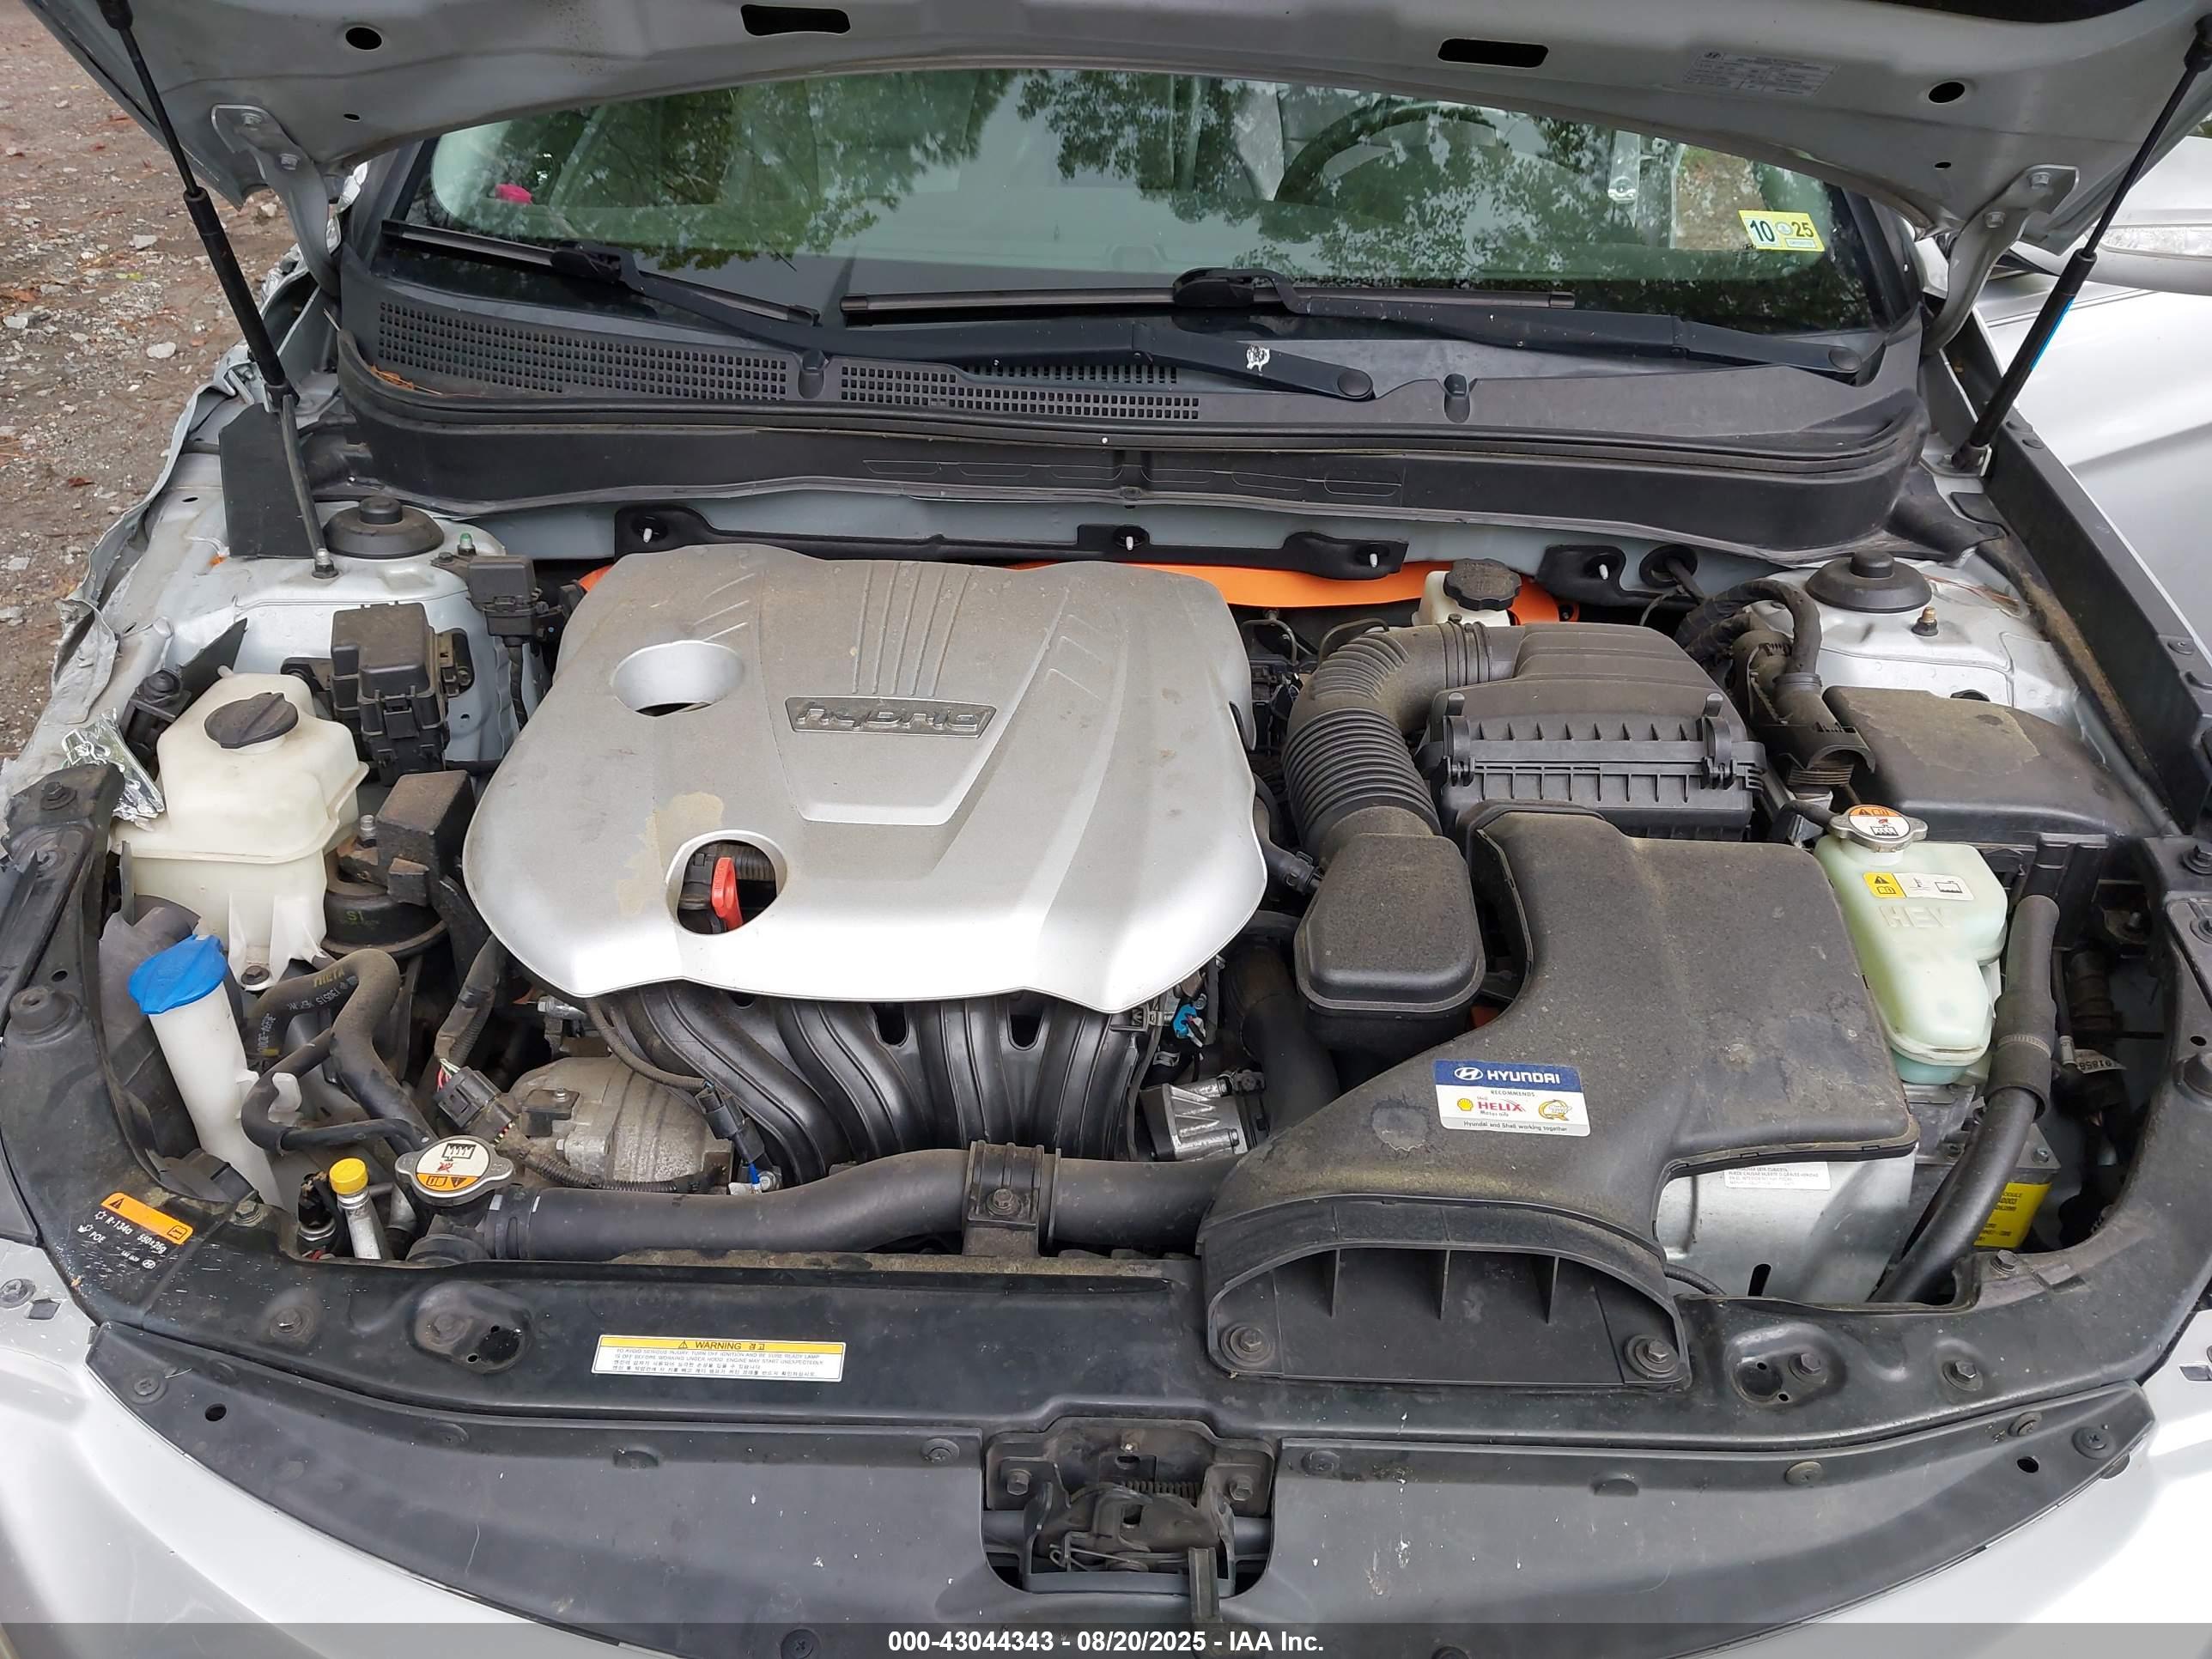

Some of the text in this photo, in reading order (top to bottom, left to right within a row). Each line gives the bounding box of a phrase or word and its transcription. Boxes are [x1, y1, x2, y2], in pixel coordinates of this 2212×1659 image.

[1749, 219, 1814, 243] 10 25
[1879, 906, 1949, 928] HEV
[1487, 1069, 1561, 1085] HYUNDAI
[1477, 1101, 1525, 1112] HELIX
[104, 1216, 134, 1236] R-134a
[88, 1231, 107, 1243] POE
[695, 1341, 742, 1350] WARNING
